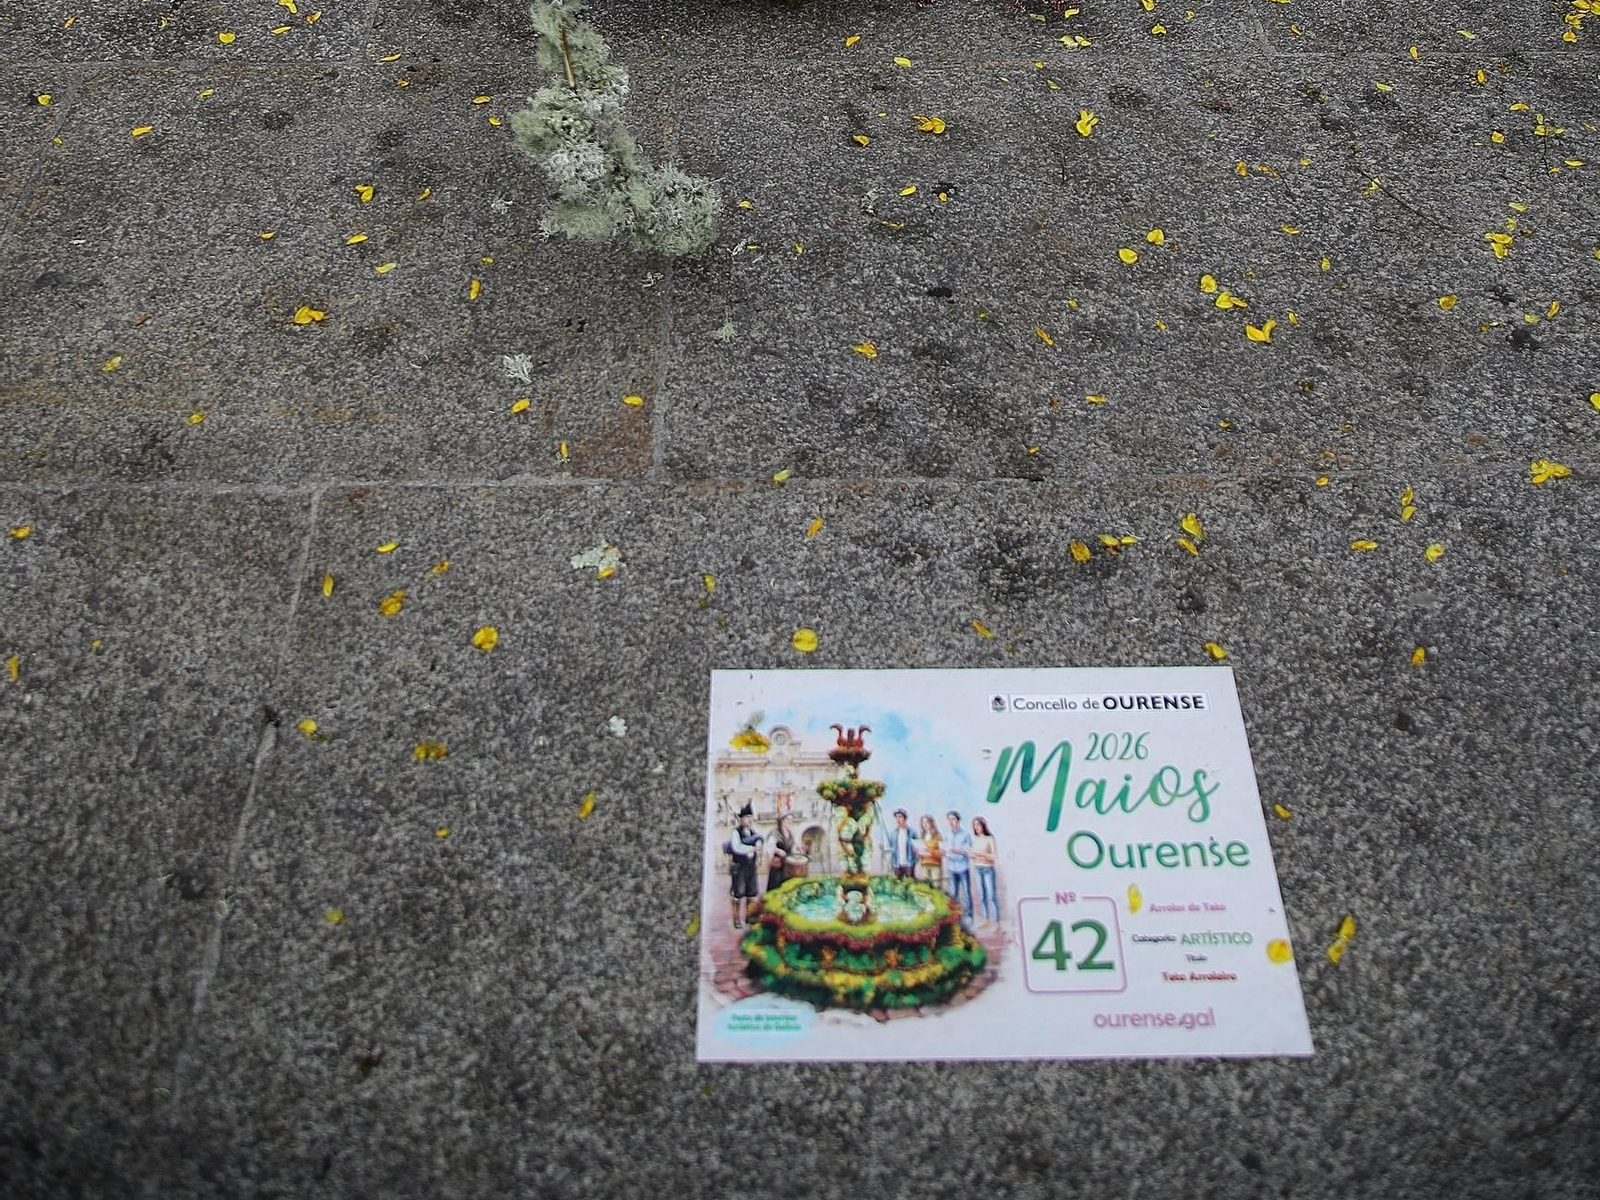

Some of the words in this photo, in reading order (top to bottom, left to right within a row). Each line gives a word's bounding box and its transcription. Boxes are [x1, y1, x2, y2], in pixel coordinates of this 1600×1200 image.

[1013, 696, 1079, 711] Concello
[1082, 696, 1101, 711] de
[1103, 695, 1206, 710] OURENSE
[1083, 731, 1151, 761] 2026
[986, 739, 1221, 833] Maios
[1066, 829, 1252, 869] Ourense
[1031, 918, 1116, 972] 42
[1180, 929, 1253, 945] ARTÍSTICO
[1093, 1007, 1217, 1030] ourense.gal
